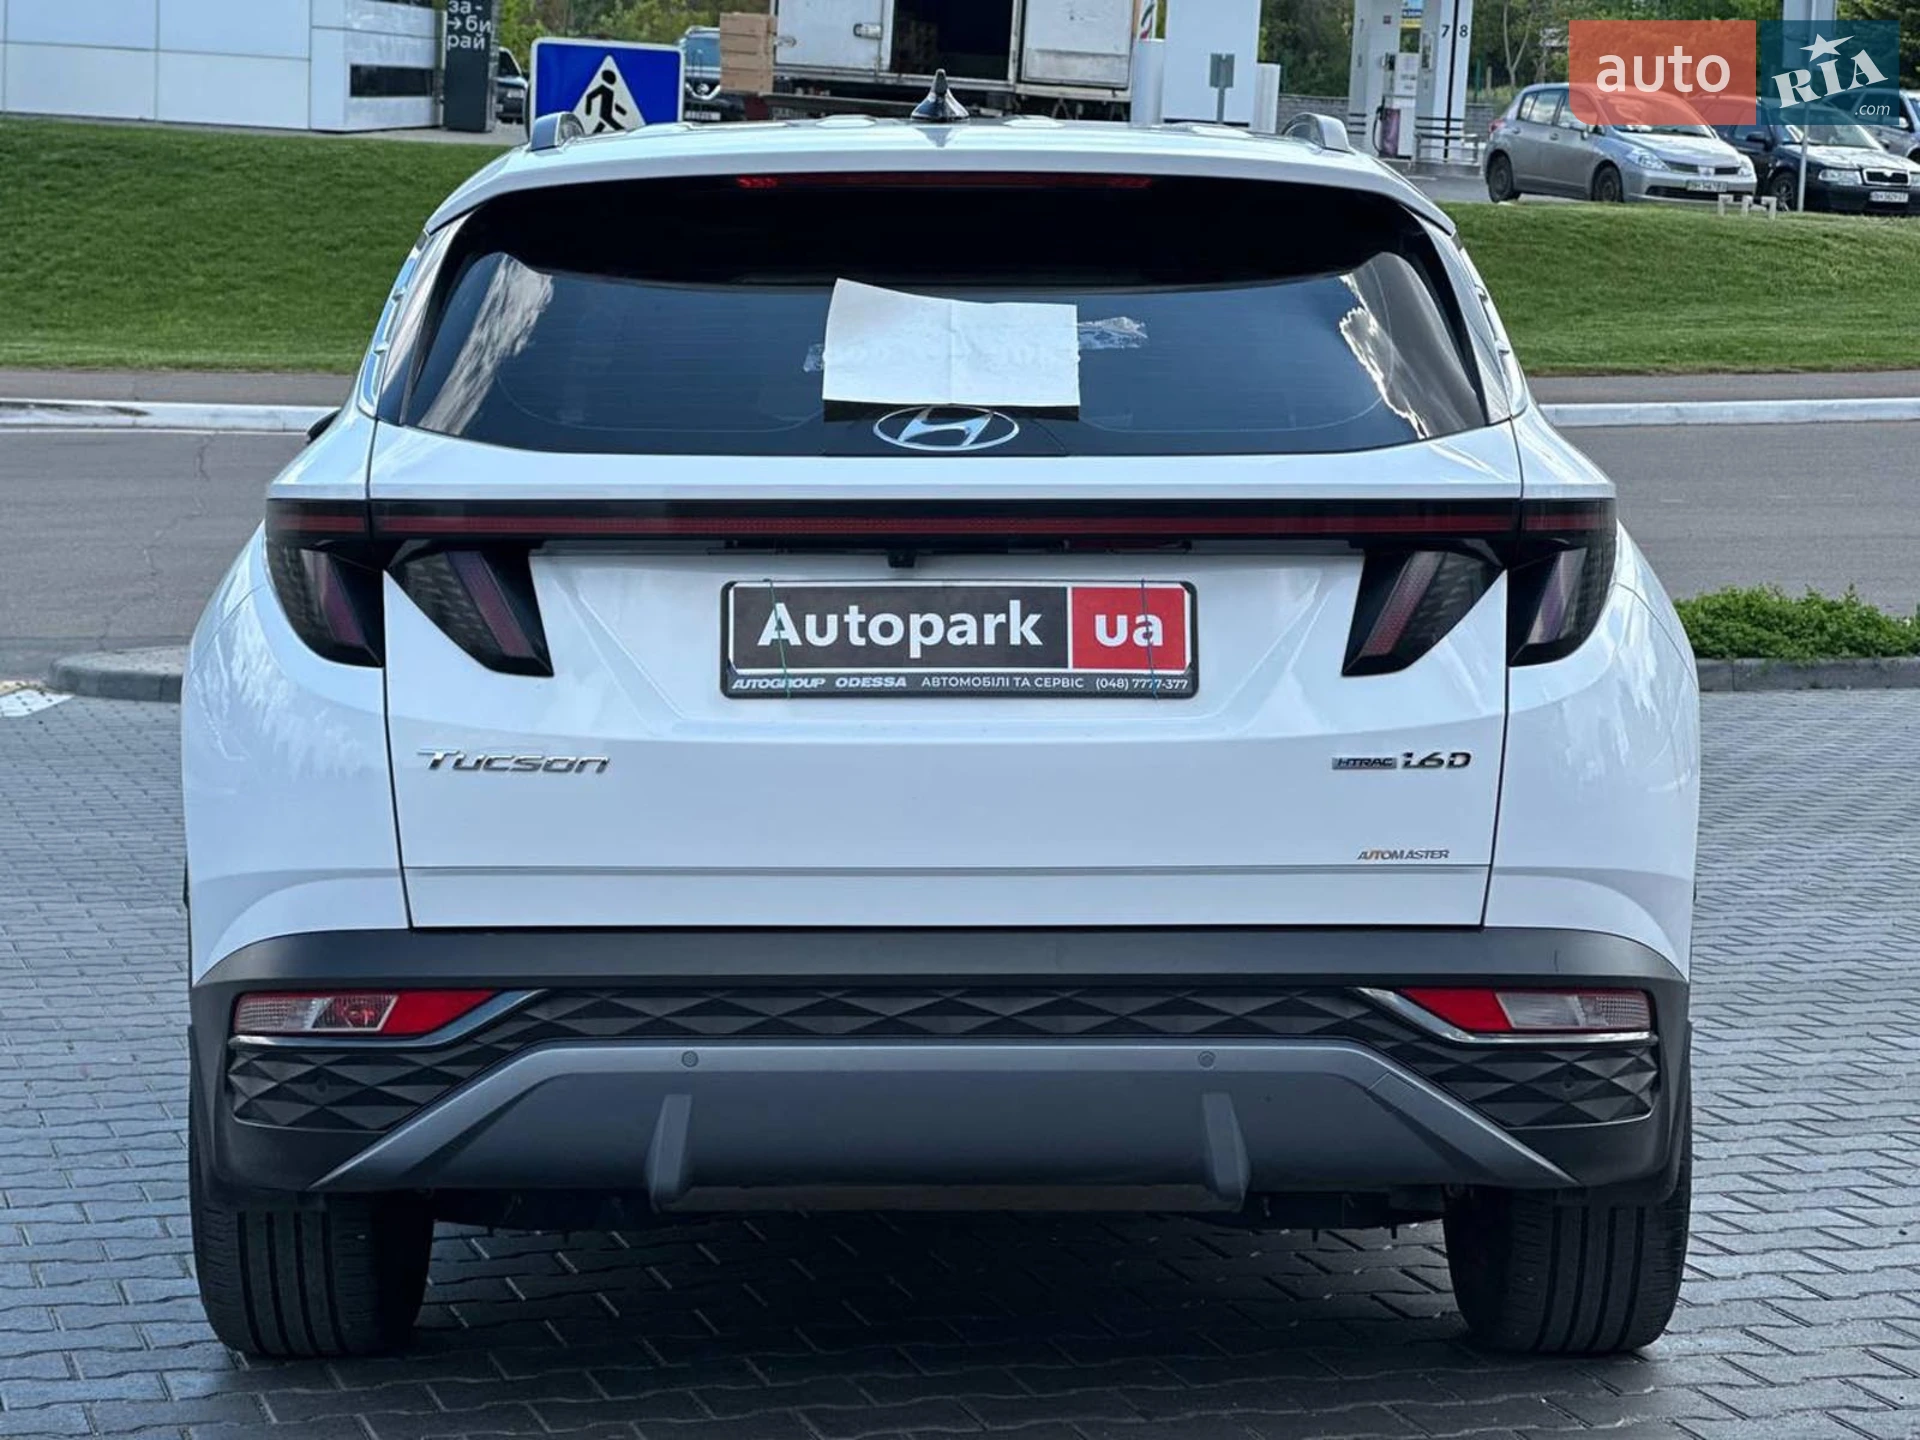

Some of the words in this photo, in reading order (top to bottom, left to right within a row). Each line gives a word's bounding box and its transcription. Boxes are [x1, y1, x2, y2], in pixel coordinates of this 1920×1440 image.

[465, 15, 491, 33] би
[1441, 24, 1450, 38] 7
[1459, 24, 1468, 38] 8
[447, 33, 485, 51] рай
[757, 600, 1043, 660] Autopark
[1094, 613, 1164, 648] ua
[732, 677, 826, 690] AUTOGROUP
[834, 676, 907, 689] ODESSA
[921, 676, 1010, 689] АВТОМОБІЛІ
[1012, 677, 1031, 689] ТА
[1034, 677, 1085, 689] СЕРВІС
[1095, 677, 1130, 691] (048)
[1131, 678, 1189, 691] 7777-377
[417, 750, 611, 775] Tucson
[1336, 757, 1395, 769] HTRAC
[1357, 849, 1450, 861] AUTOMASTER
